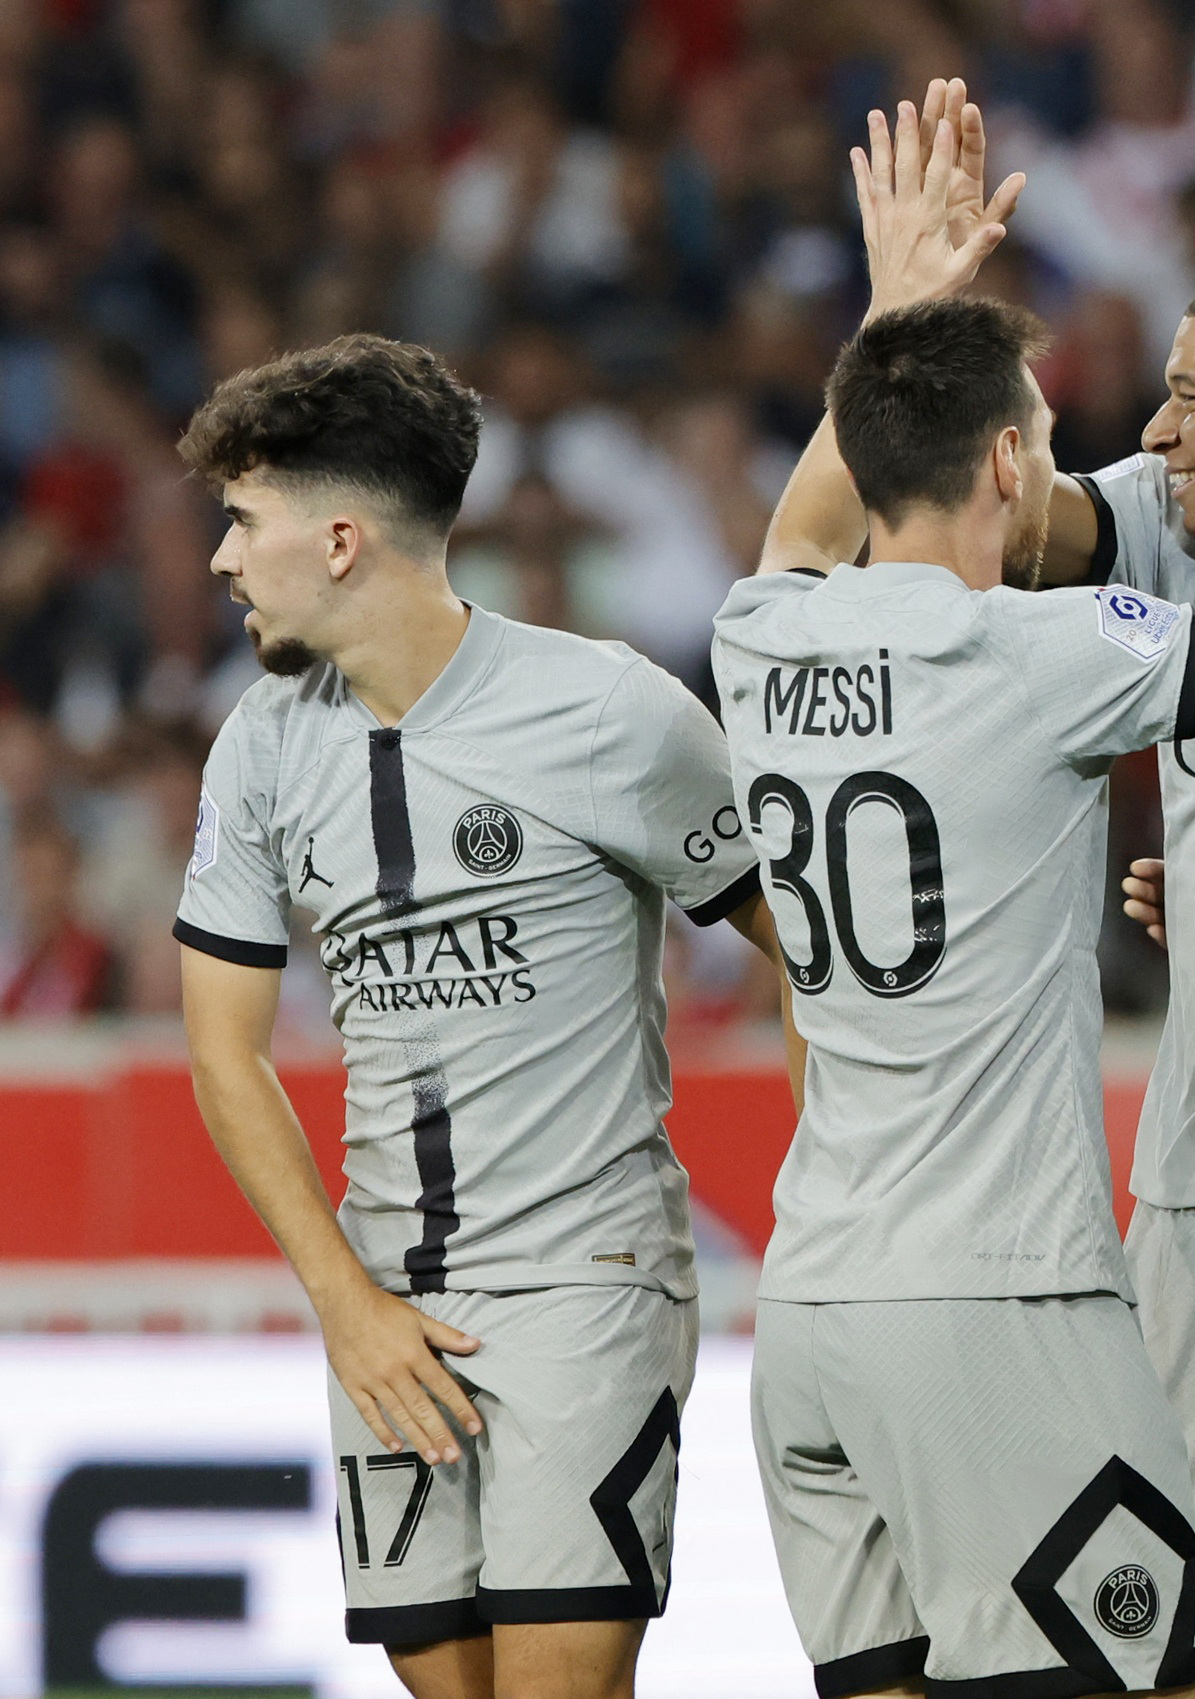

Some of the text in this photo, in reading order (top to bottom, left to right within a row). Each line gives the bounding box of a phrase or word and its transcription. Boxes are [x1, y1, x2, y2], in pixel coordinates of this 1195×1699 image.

[463, 809, 507, 829] PARIS
[747, 771, 948, 998] 30
[321, 915, 530, 987] QATAR
[360, 969, 537, 1012] AIRWAYS
[340, 1451, 434, 1569] 17
[1108, 1570, 1148, 1589] PARIS
